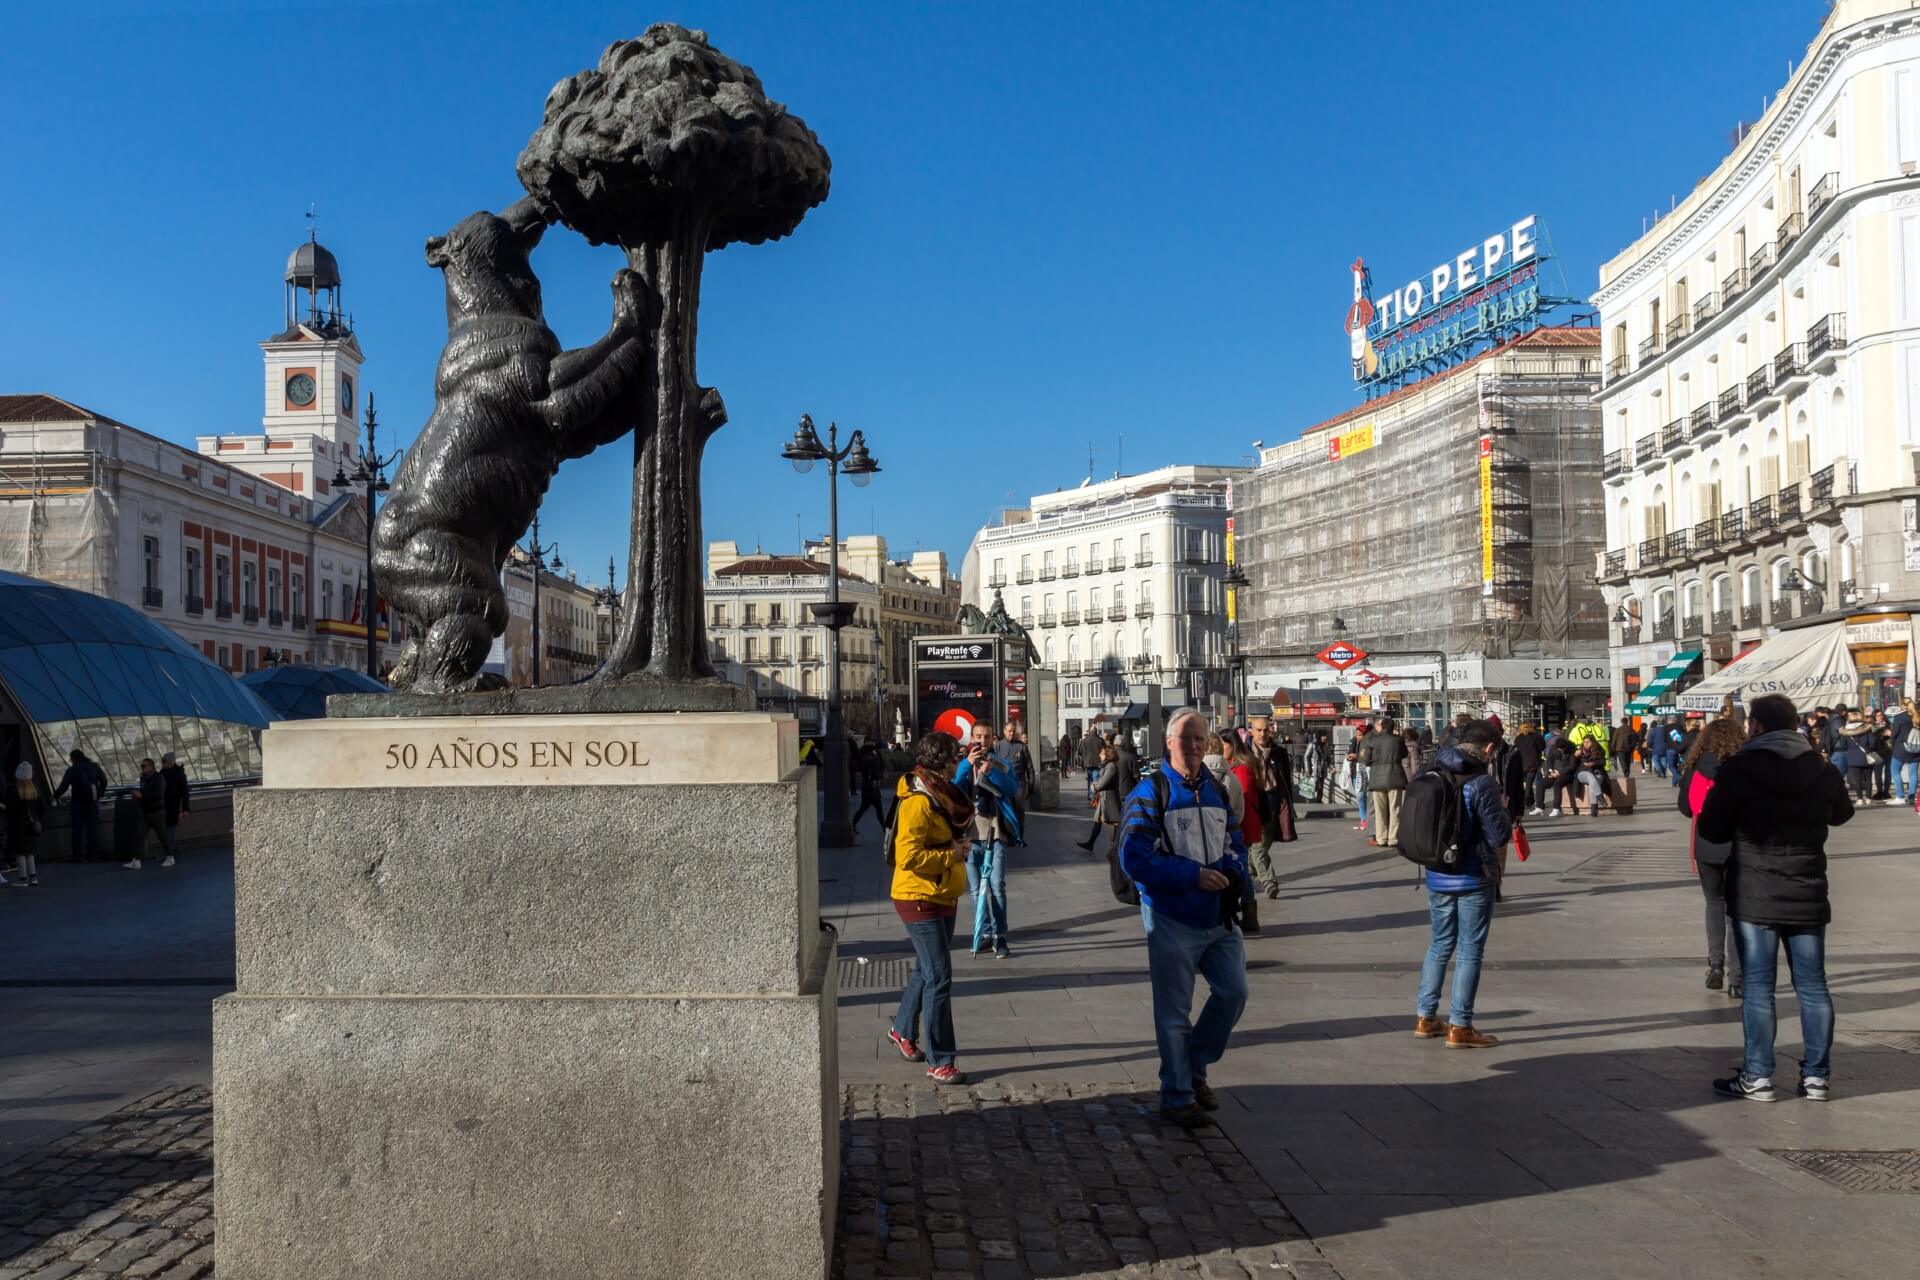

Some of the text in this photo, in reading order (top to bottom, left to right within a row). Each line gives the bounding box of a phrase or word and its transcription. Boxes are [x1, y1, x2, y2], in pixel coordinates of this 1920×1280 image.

[1376, 280, 1423, 331] TIO
[1432, 214, 1536, 304] PEPE
[1478, 285, 1539, 333] BYASS
[927, 645, 968, 657] PlayRenfe
[1330, 651, 1353, 659] Metro
[1533, 667, 1611, 680] SEPHOR
[929, 681, 957, 694] renfe
[1749, 680, 1788, 693] CASA
[1805, 672, 1851, 688] DIEGO
[385, 737, 650, 770] 50 AÑOS EN SOL
